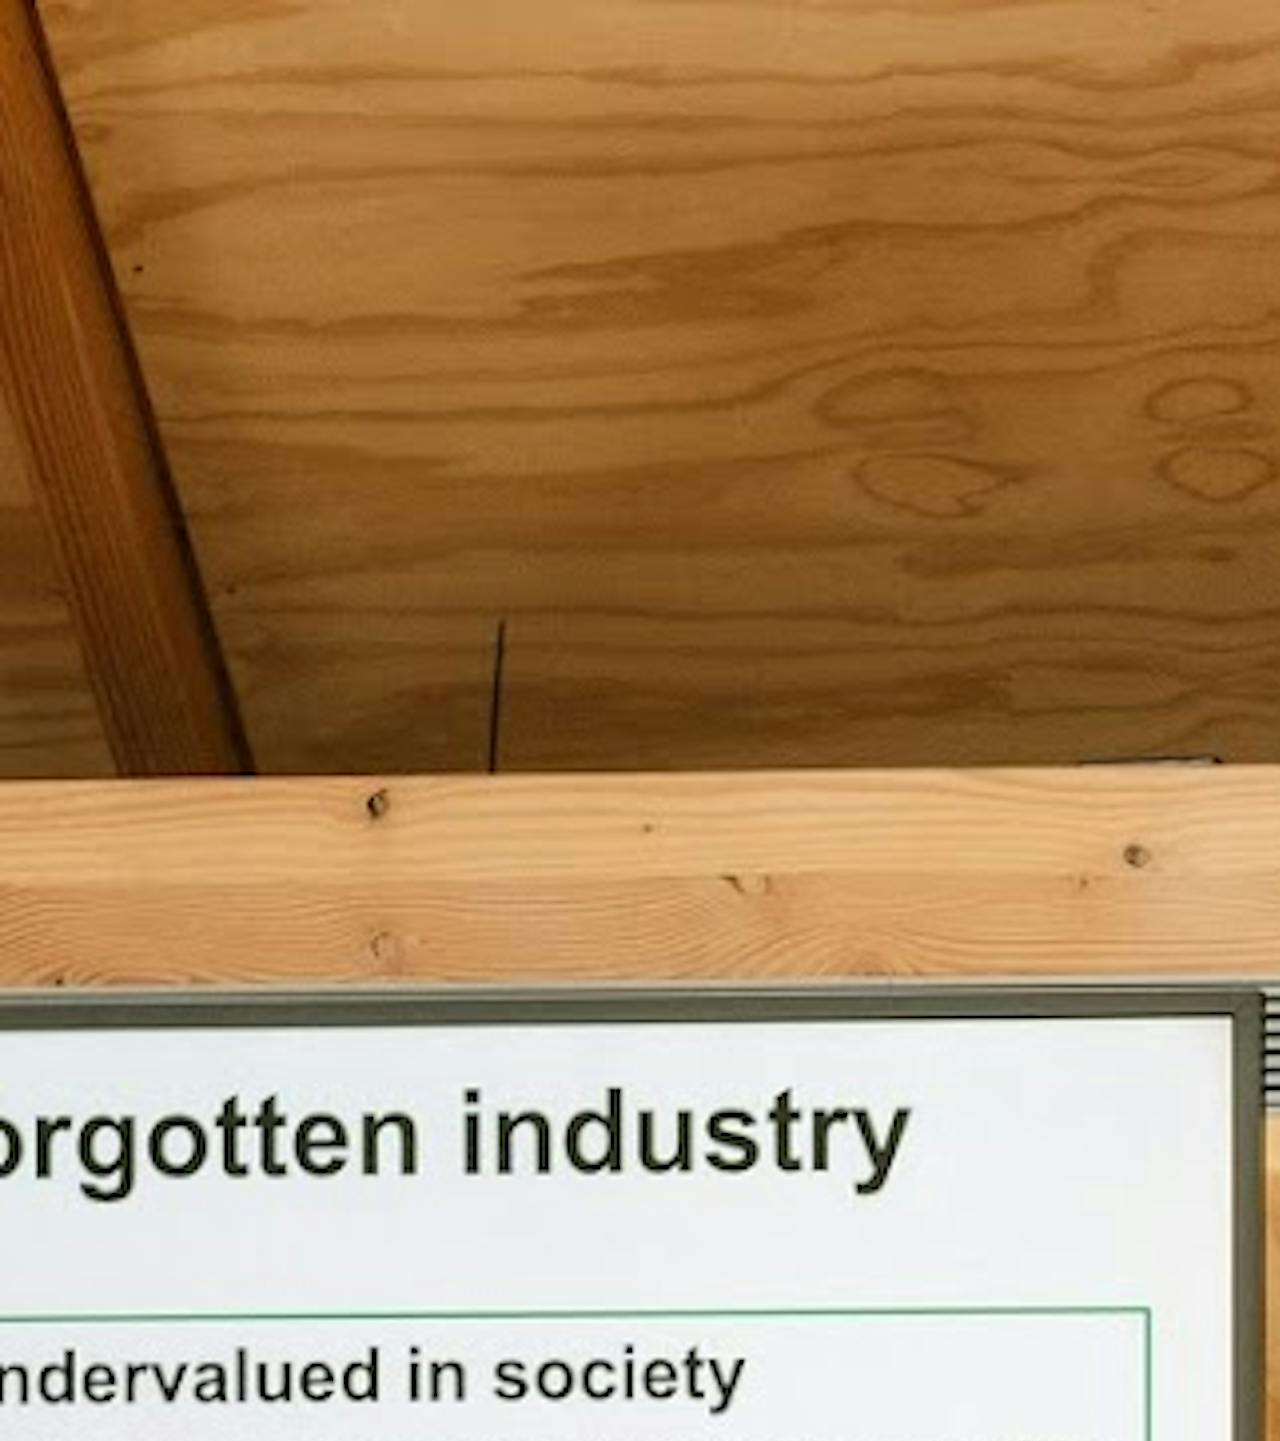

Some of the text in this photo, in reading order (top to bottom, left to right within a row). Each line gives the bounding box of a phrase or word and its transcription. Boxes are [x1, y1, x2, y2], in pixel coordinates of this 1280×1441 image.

[462, 1085, 912, 1196] industry
[407, 1344, 467, 1403] in
[492, 1342, 747, 1416] society
